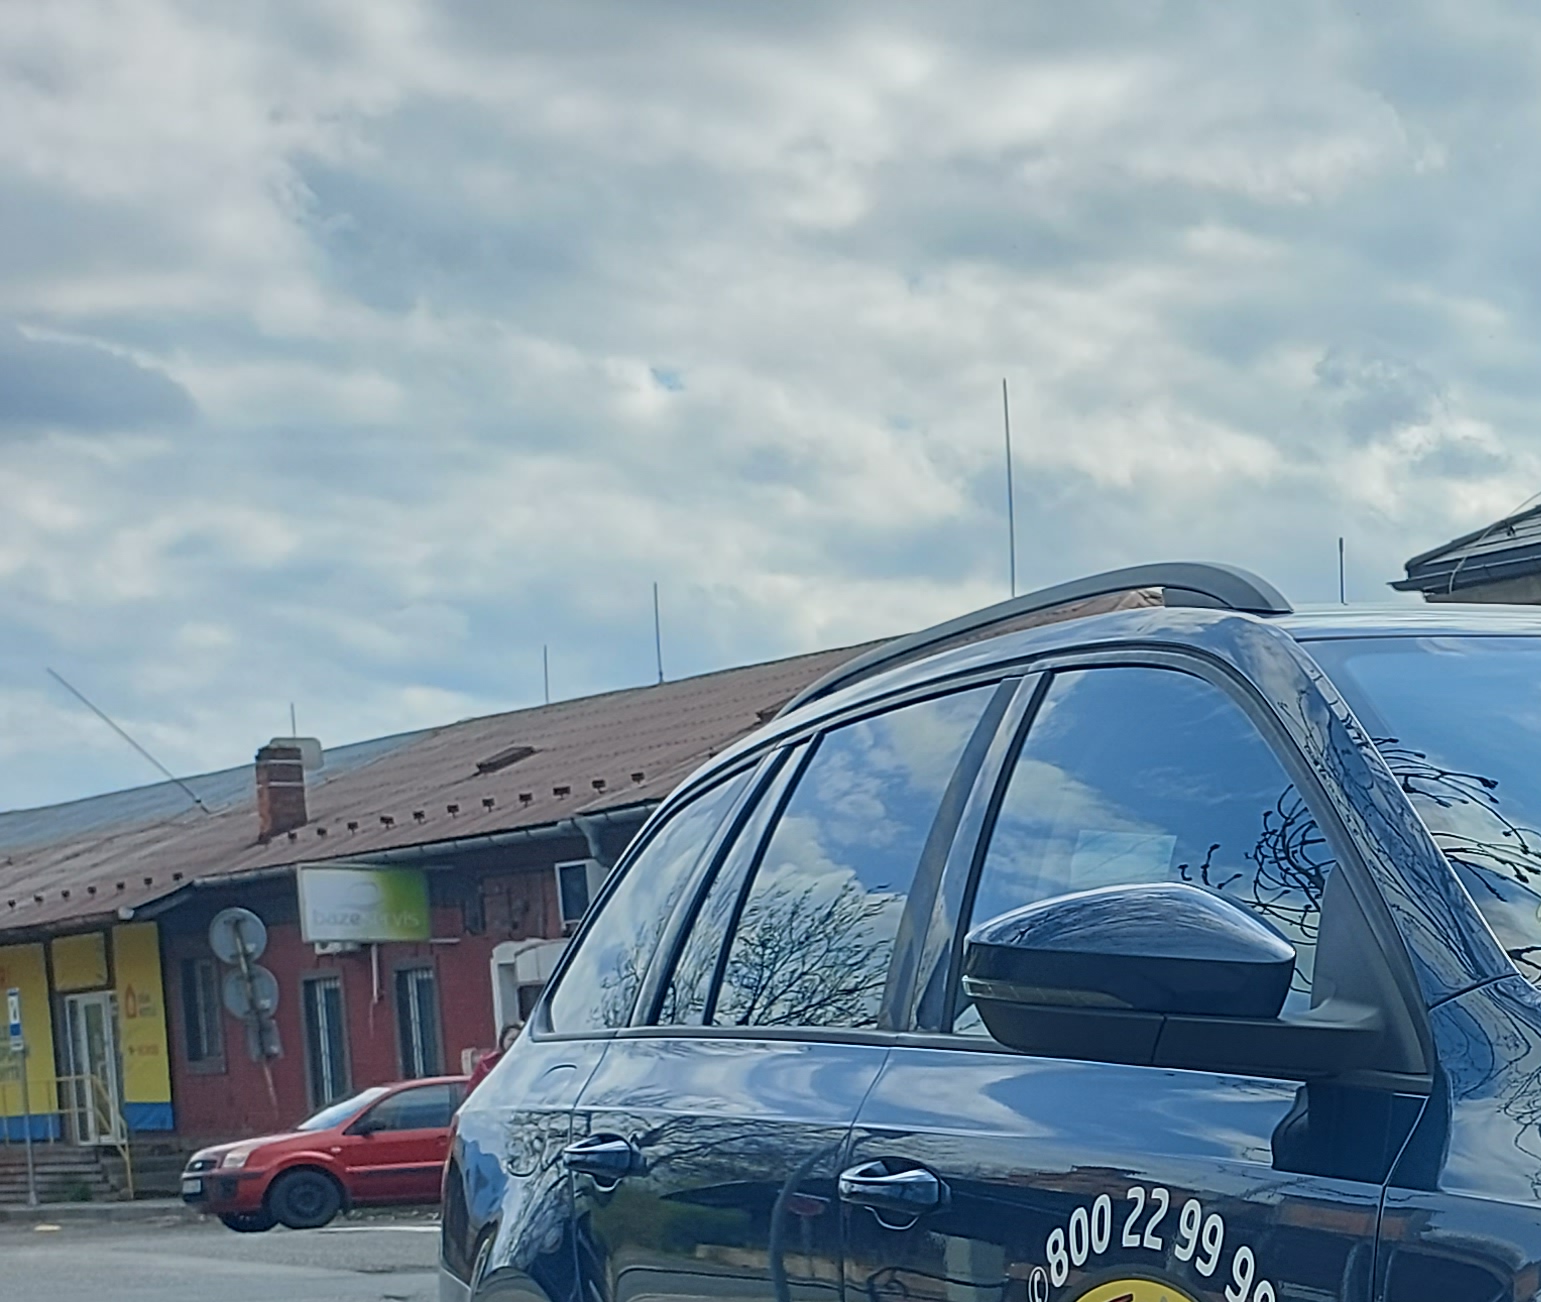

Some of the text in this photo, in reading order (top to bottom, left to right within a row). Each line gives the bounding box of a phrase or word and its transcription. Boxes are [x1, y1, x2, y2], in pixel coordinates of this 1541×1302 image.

[1046, 1193, 1112, 1288] 800
[1122, 1186, 1170, 1251] 22
[1174, 1198, 1224, 1278] 99
